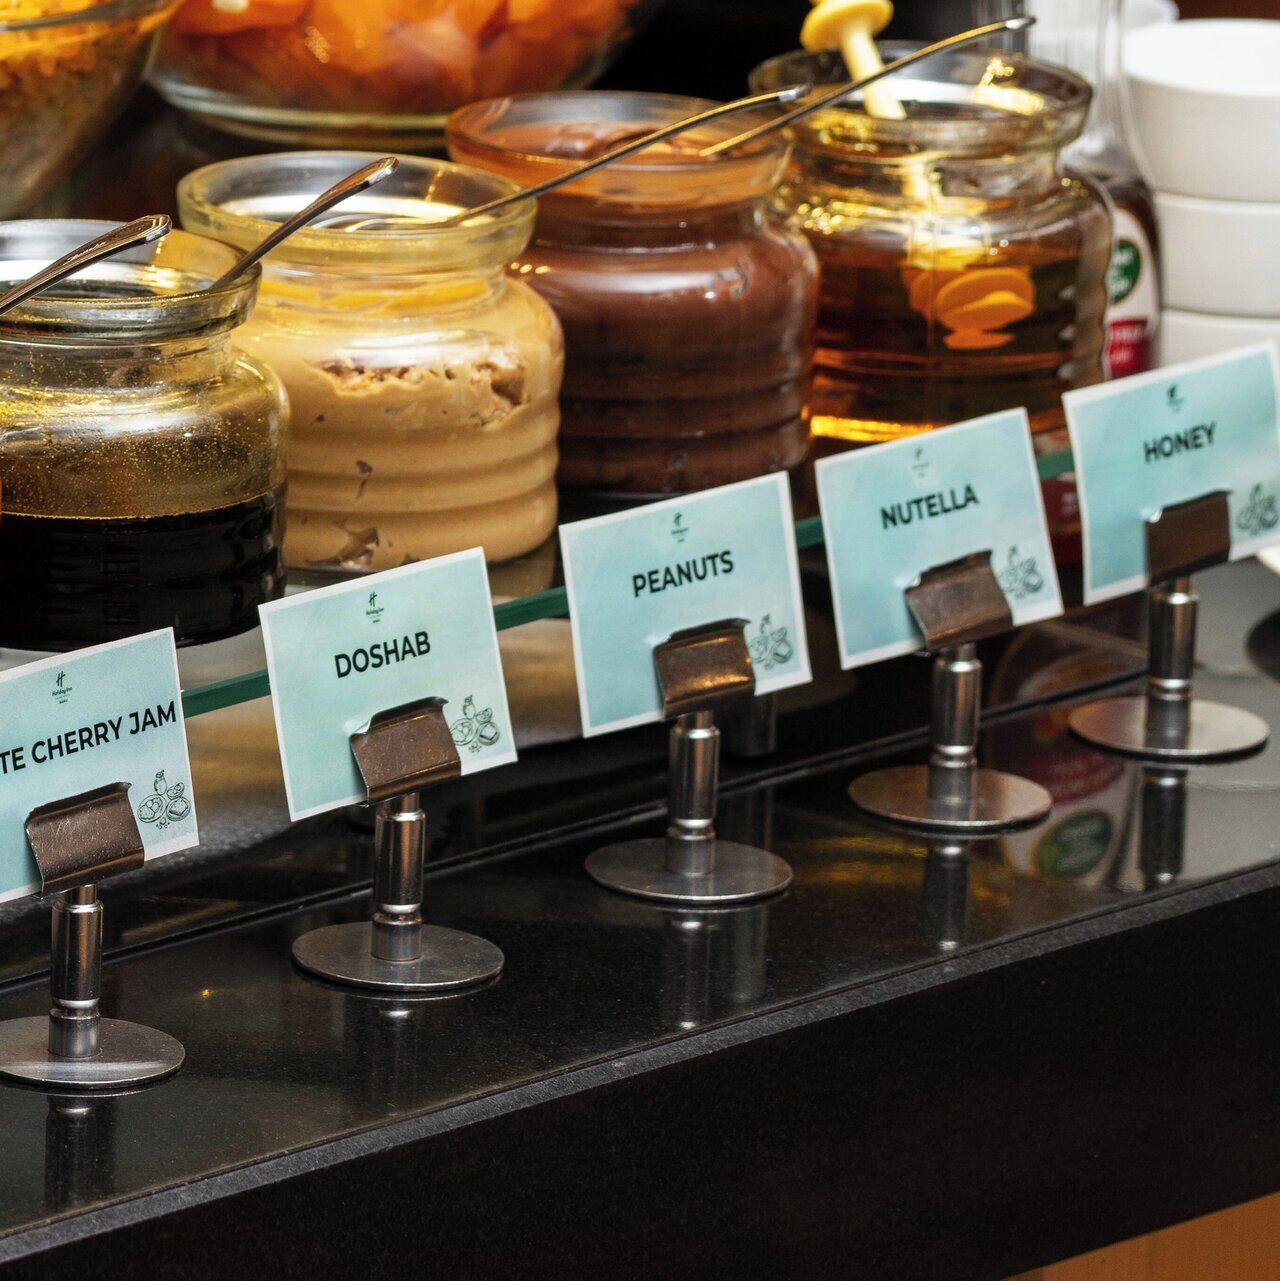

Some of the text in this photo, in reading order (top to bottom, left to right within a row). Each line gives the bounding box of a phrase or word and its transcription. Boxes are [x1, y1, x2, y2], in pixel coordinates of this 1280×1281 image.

[1143, 421, 1216, 463] HONEY
[881, 483, 979, 530] NUTELLA
[633, 550, 734, 597] PEANUTS
[334, 631, 431, 678] DOSHAB
[31, 716, 123, 763] CHERRY
[129, 701, 177, 735] JAM
